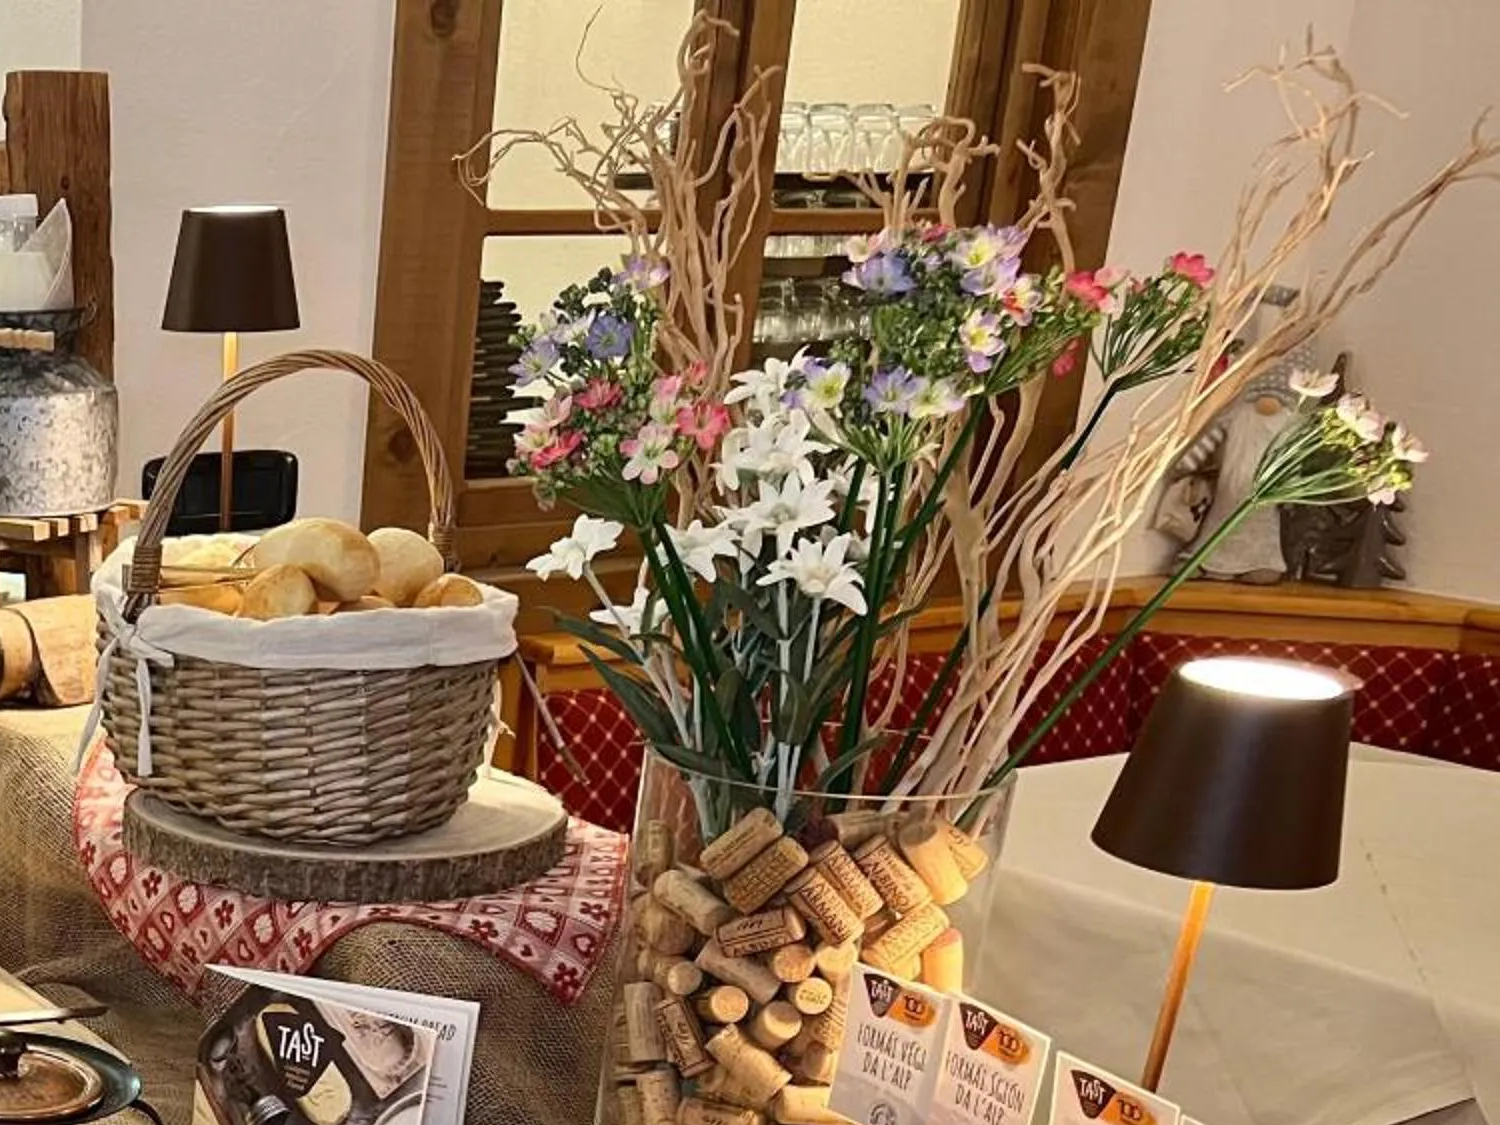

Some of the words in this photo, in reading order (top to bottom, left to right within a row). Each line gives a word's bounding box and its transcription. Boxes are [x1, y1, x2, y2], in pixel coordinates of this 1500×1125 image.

[965, 1010, 989, 1035] TAST
[278, 1022, 324, 1067] TAST
[862, 1051, 877, 1077] DA
[955, 1083, 972, 1111] DA
[1080, 1078, 1106, 1105] TAST
